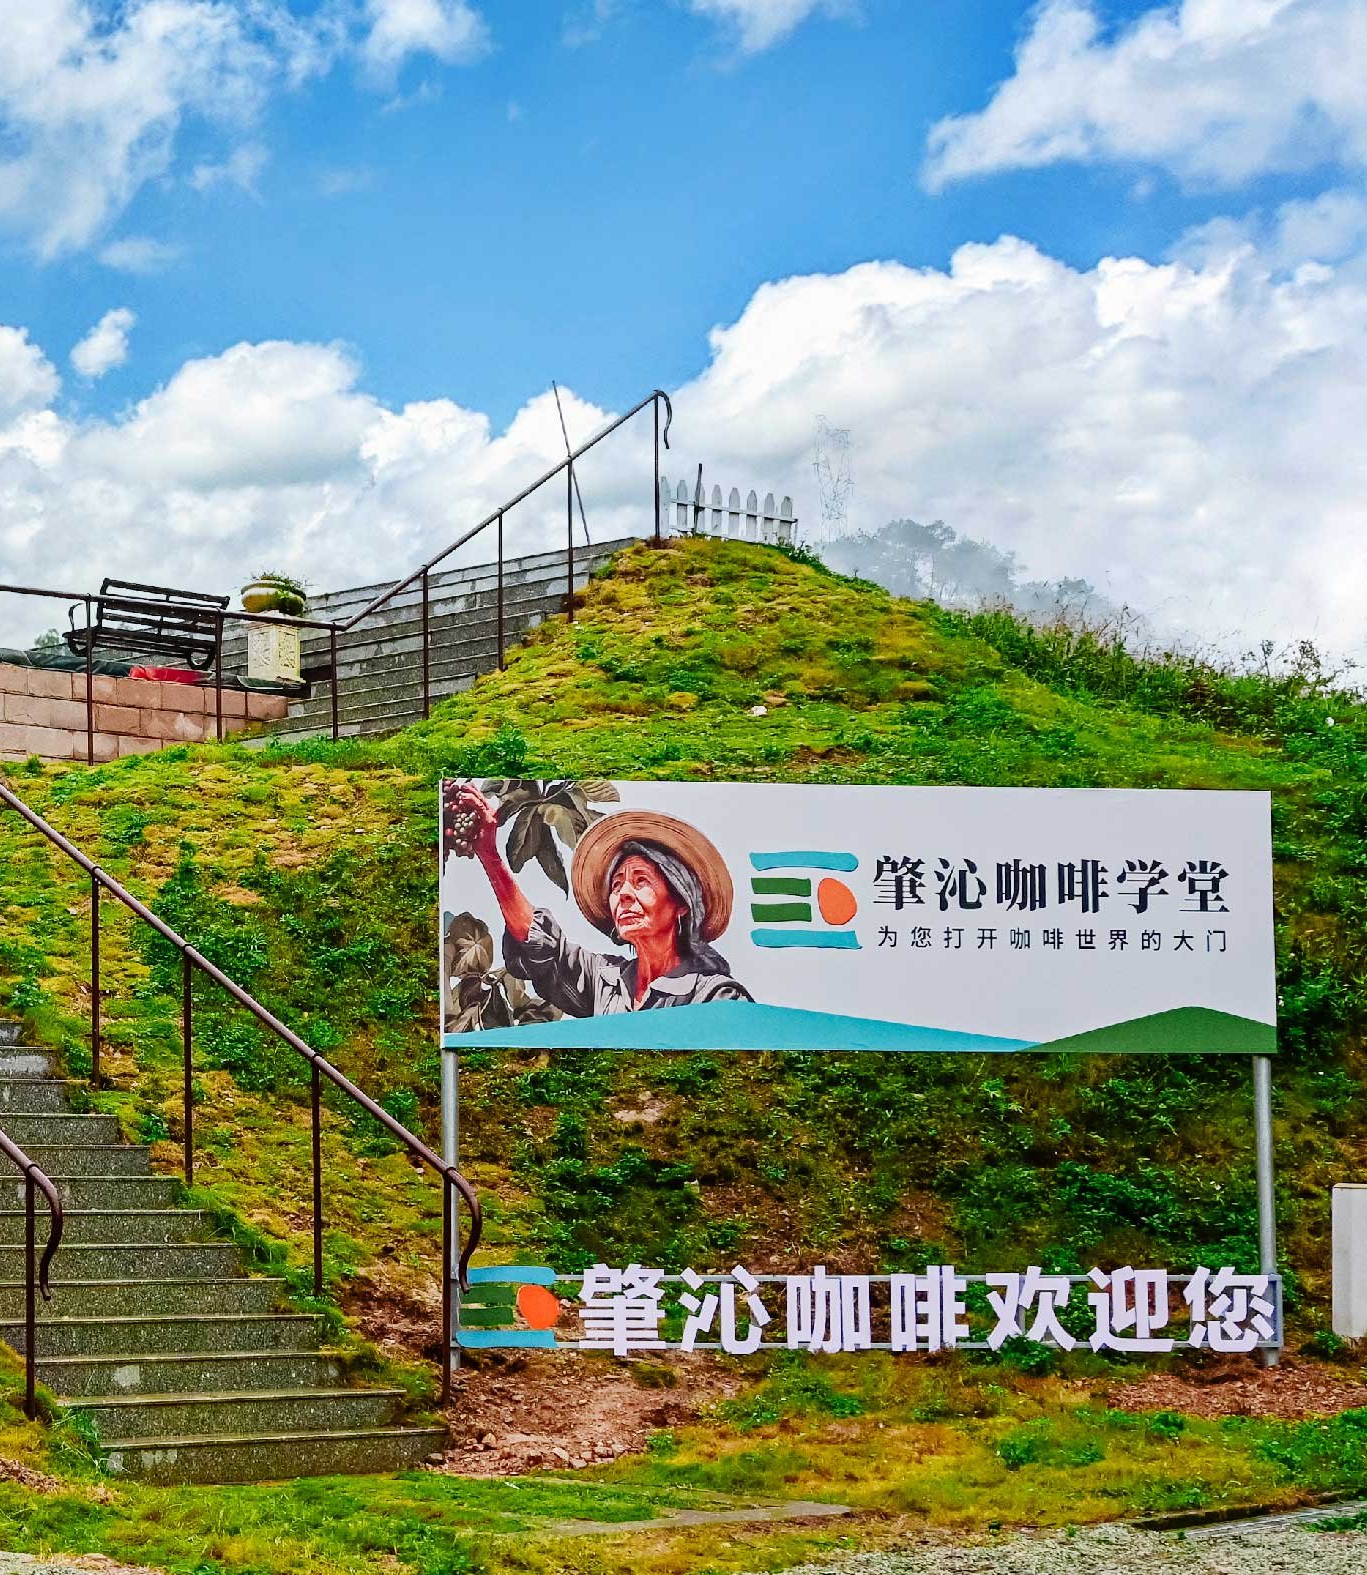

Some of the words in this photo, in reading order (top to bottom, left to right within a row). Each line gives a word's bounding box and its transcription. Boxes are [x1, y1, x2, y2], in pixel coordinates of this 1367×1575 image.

[872, 855, 1232, 914] 肇沁咖啡学堂
[876, 925, 1228, 953] 为您打开咖啡世界的大门
[578, 1262, 1277, 1355] 肇沁咖啡欢迎您
